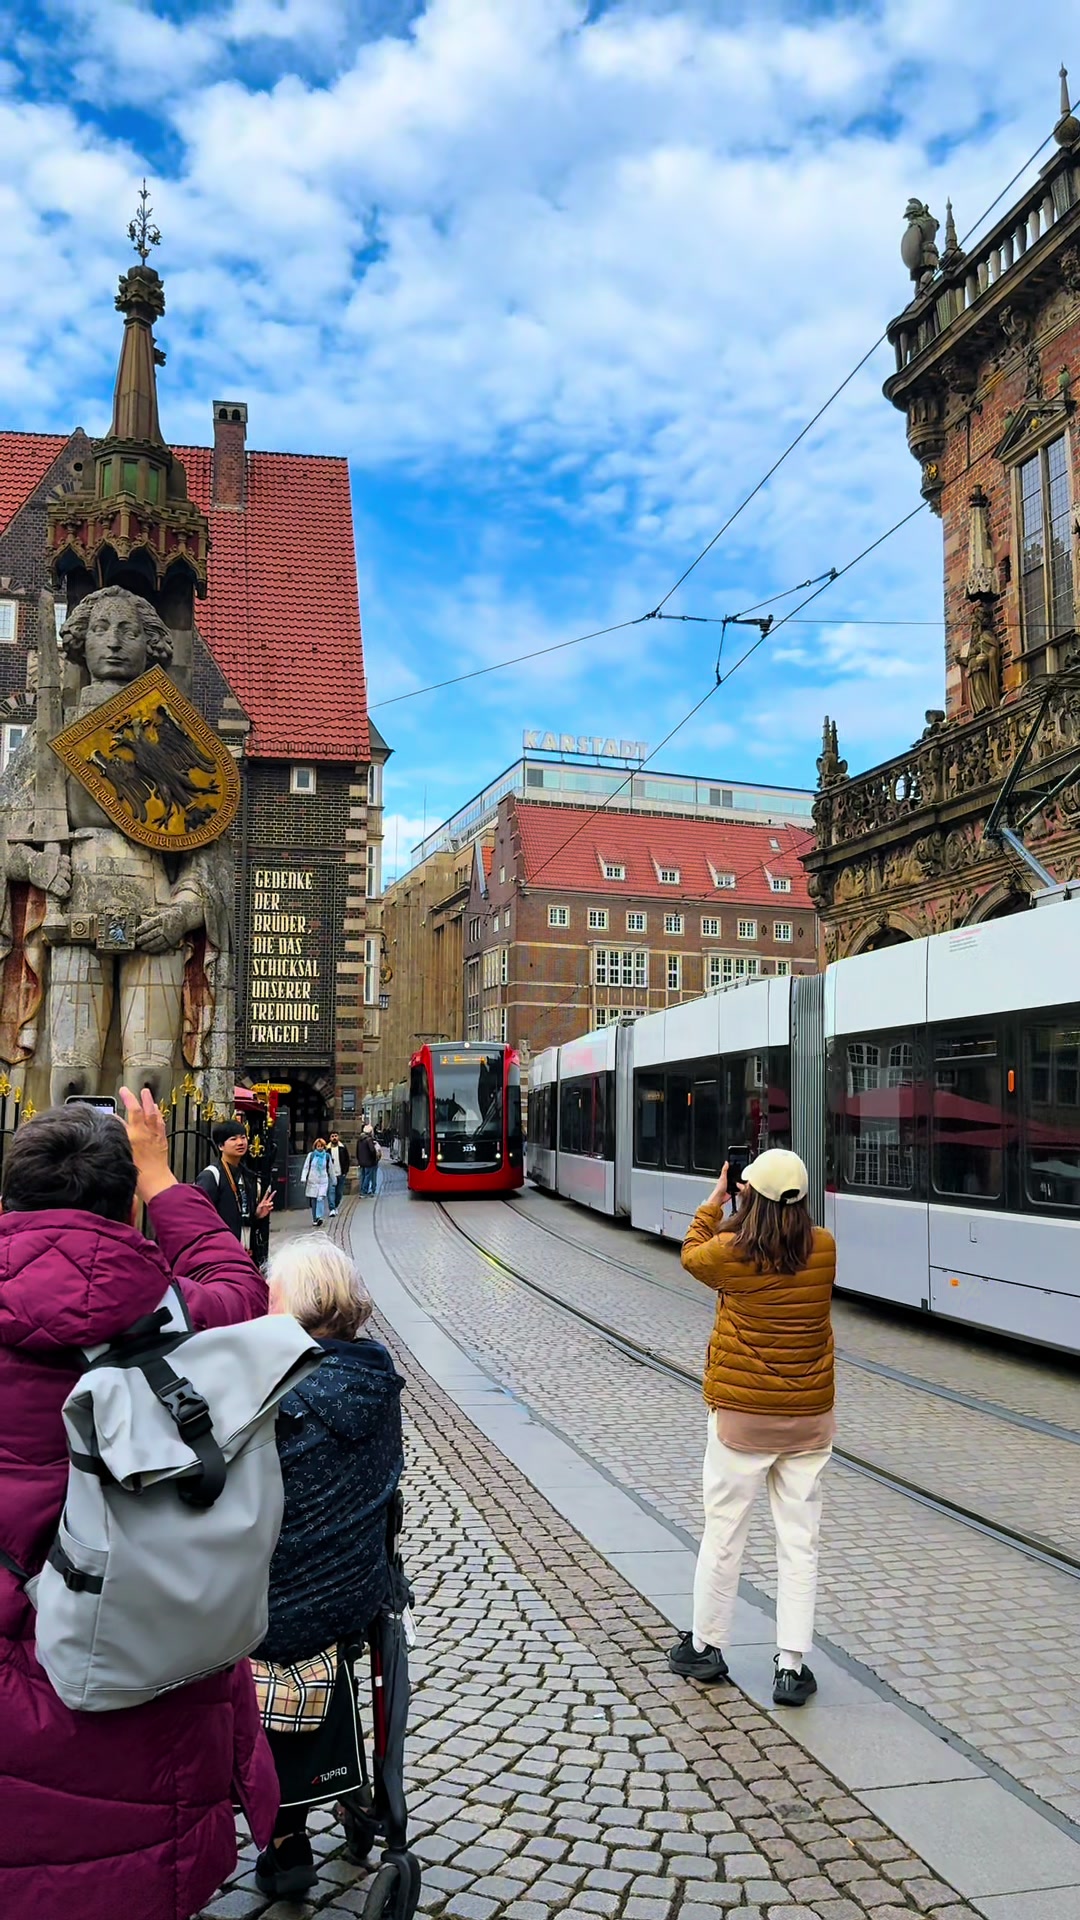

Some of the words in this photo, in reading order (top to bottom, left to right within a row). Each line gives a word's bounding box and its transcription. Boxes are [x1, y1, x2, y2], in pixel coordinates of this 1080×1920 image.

[523, 729, 648, 759] KARSTADT
[255, 870, 313, 890] GEDENKE
[254, 892, 279, 910] DER
[254, 912, 312, 934] BRÜDER,
[253, 936, 274, 954] DIE
[279, 937, 303, 955] DAS
[252, 958, 320, 977] SCHICKSAL
[252, 980, 311, 999] UNSERER
[251, 1002, 320, 1021] TRENNUNG
[320, 1766, 347, 1782] TOPRO
